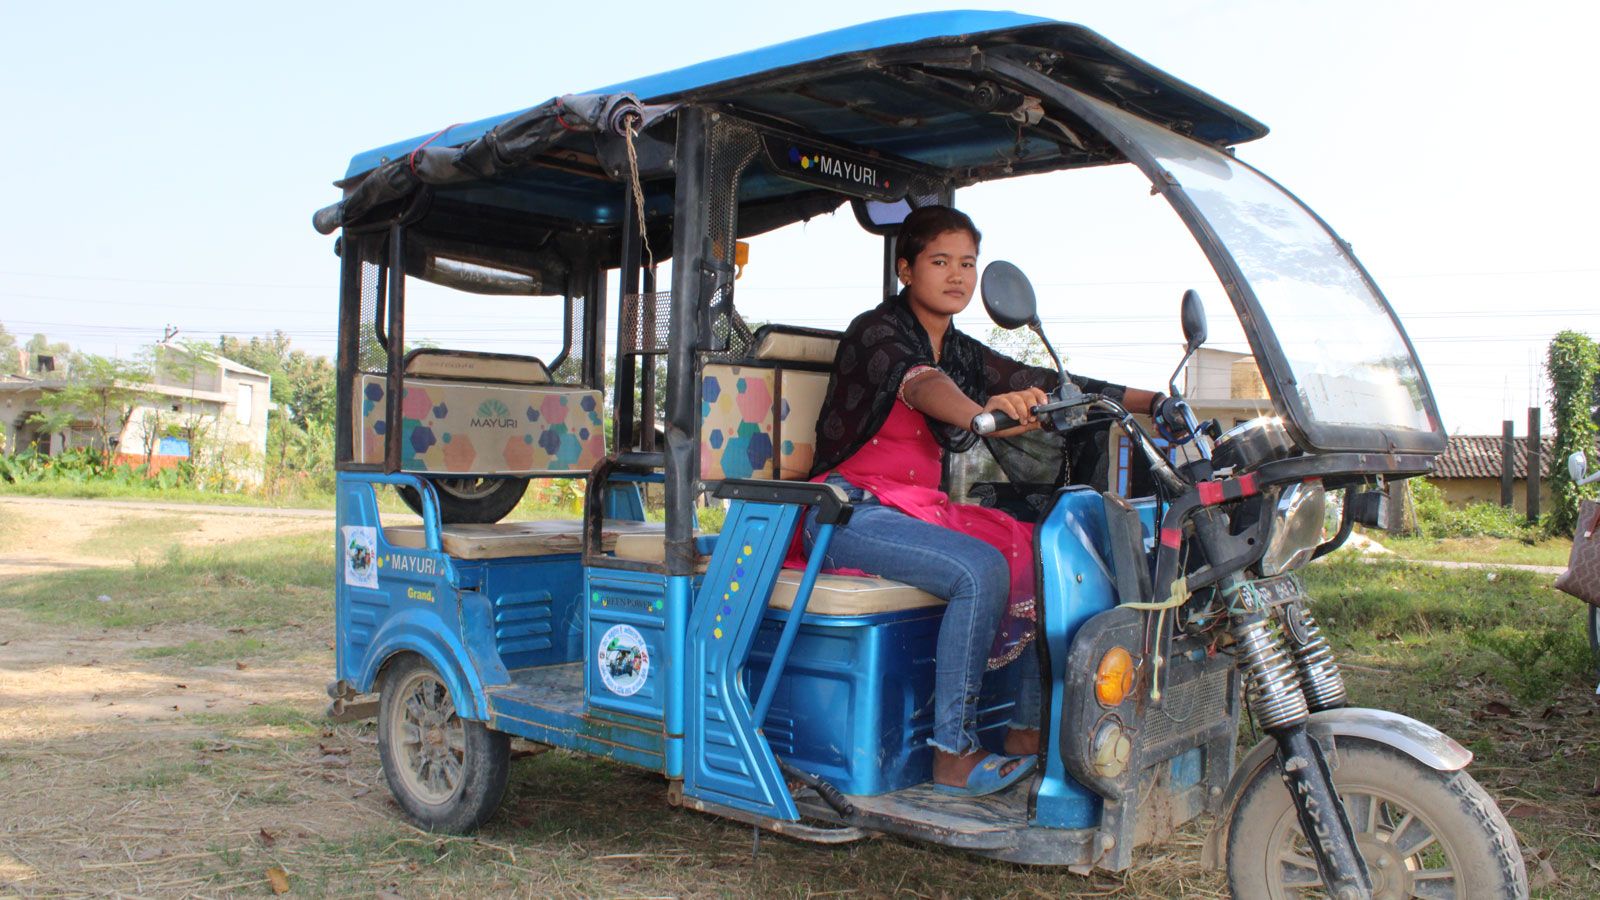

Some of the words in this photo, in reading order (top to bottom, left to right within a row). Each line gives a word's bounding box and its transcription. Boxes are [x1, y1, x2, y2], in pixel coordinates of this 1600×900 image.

[820, 155, 876, 186] MAYURI
[470, 418, 518, 429] MAYURI
[391, 553, 436, 575] MAYURI
[1297, 781, 1338, 868] MAYURI
